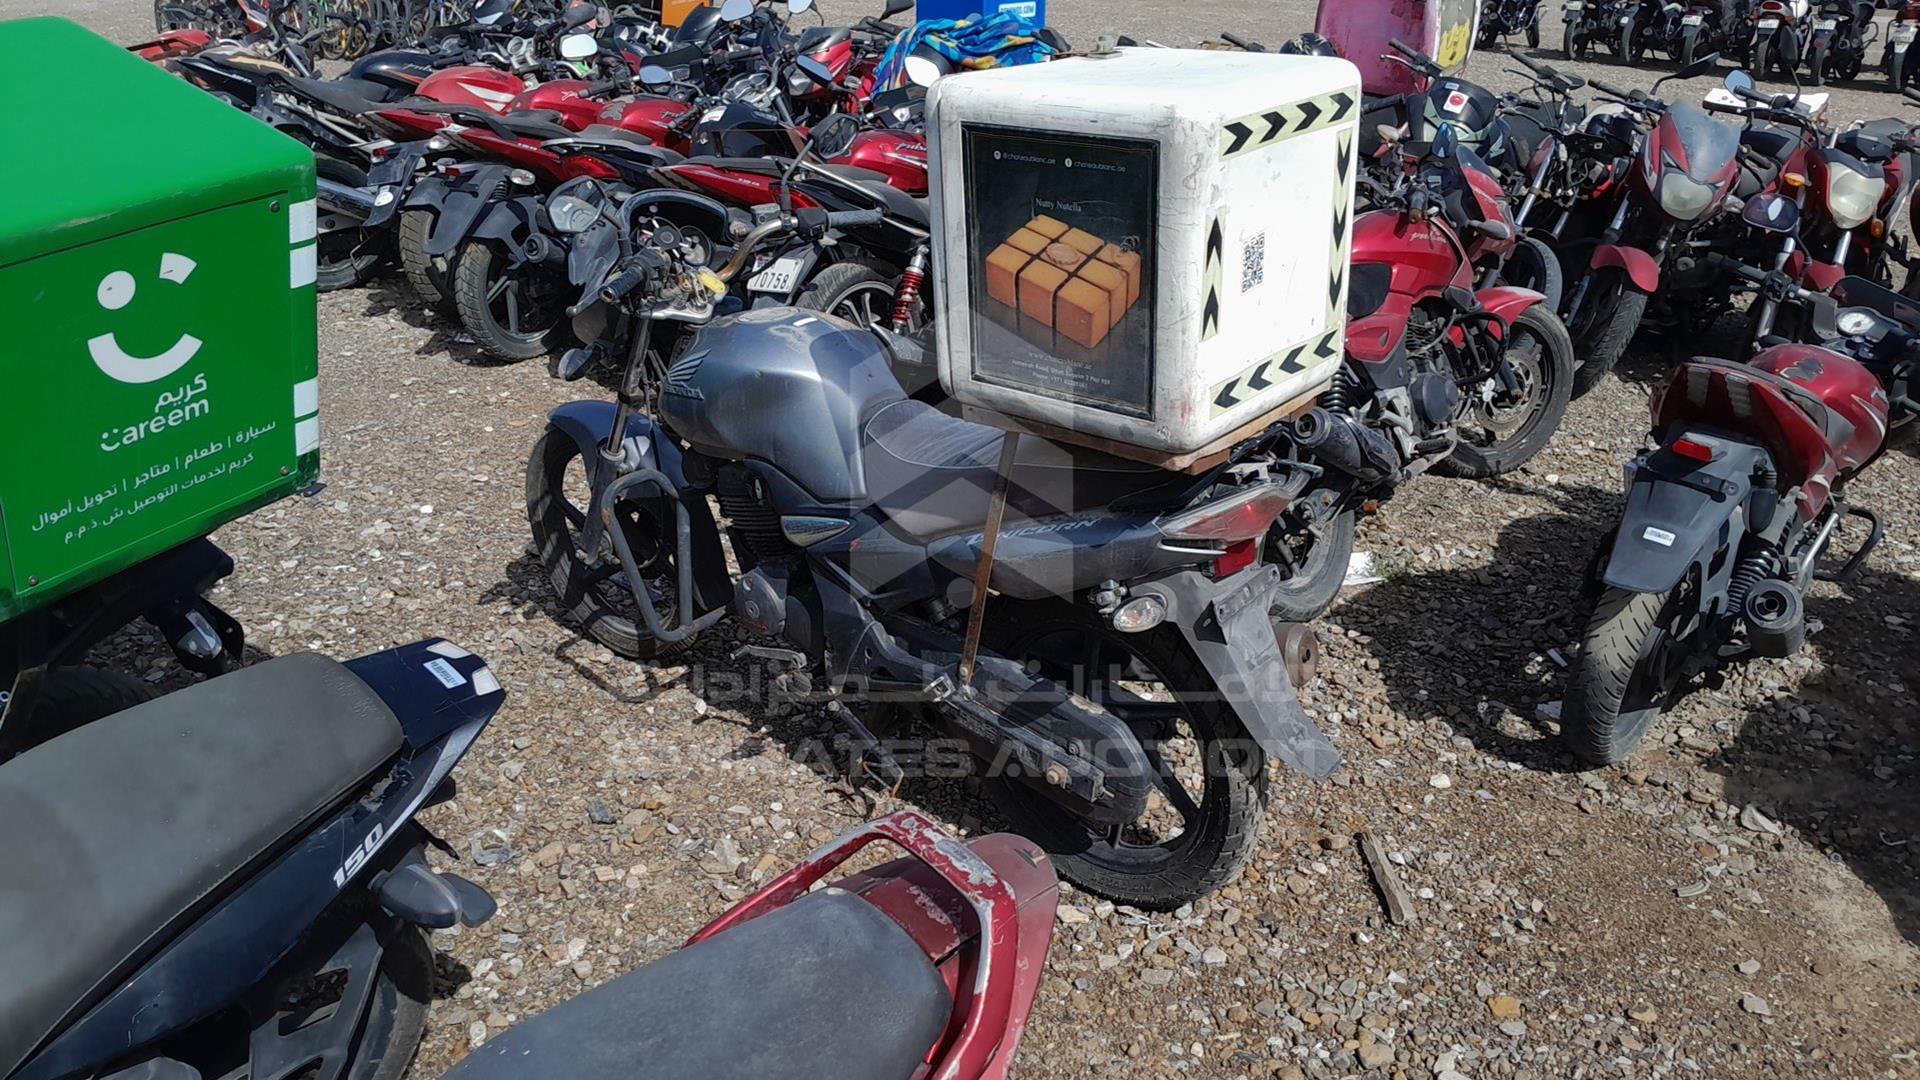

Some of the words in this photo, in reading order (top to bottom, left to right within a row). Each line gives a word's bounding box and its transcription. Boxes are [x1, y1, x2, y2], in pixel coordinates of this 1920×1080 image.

[1056, 200, 1081, 212] Nutella
[155, 372, 207, 414] كريم
[235, 420, 276, 444] سيارة
[184, 441, 223, 469] طعام
[228, 452, 254, 474] كريم
[133, 462, 171, 489] متاجر
[181, 463, 226, 489] لخدمات
[76, 484, 118, 513] تحويل
[127, 483, 178, 515] التوصيل
[31, 498, 72, 532] أموال
[333, 822, 385, 889] 150
